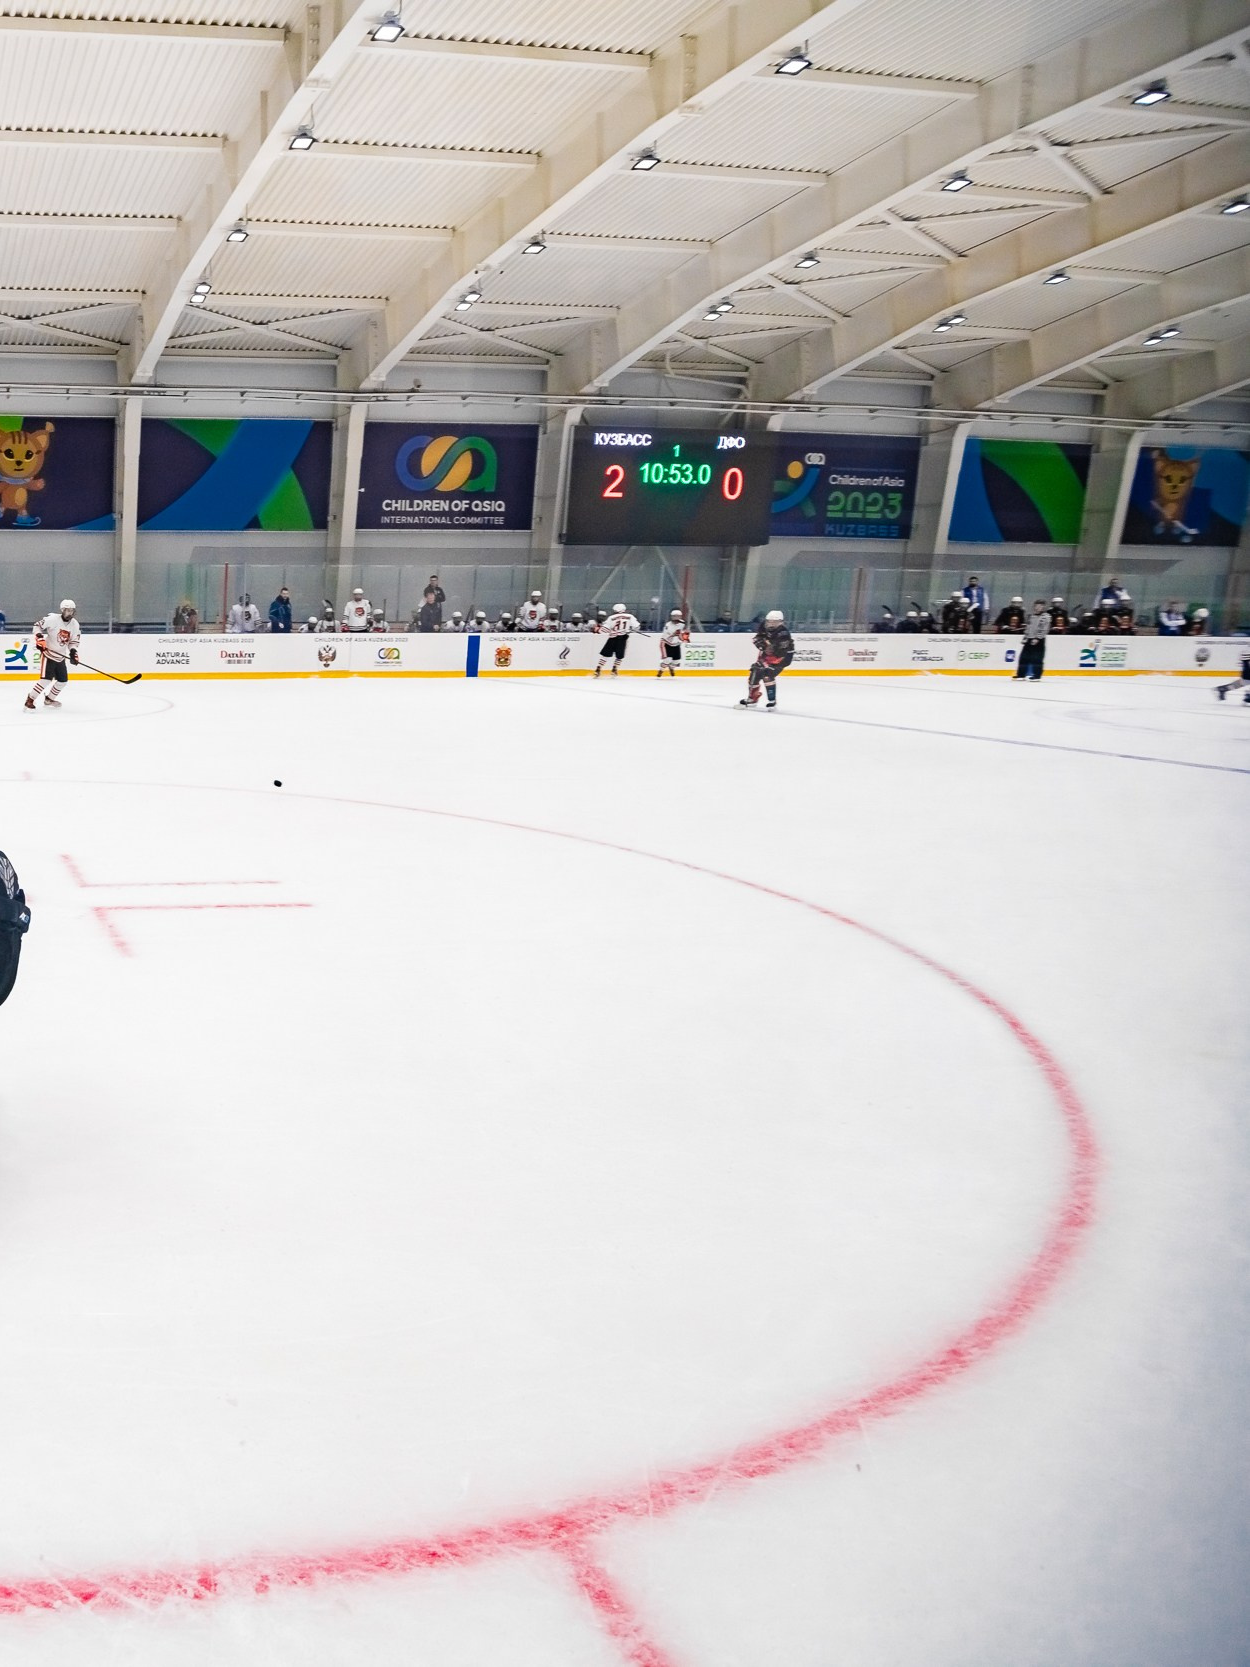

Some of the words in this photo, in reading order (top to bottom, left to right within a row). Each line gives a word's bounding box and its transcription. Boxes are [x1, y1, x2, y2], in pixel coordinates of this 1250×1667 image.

[594, 432, 652, 446] КУЗБАСС
[717, 436, 745, 449] ДФО
[673, 445, 680, 457] 1
[640, 462, 711, 485] 10:53.0
[603, 464, 625, 498] 2
[722, 467, 743, 500] 0
[382, 499, 449, 512] CHILDREN
[451, 500, 469, 512] OF
[826, 491, 902, 519] 2023
[381, 516, 451, 524] INTERNATIONAL
[453, 516, 505, 525] COMMITTEE
[825, 523, 899, 537] KUZBASS
[685, 650, 715, 660] 2023
